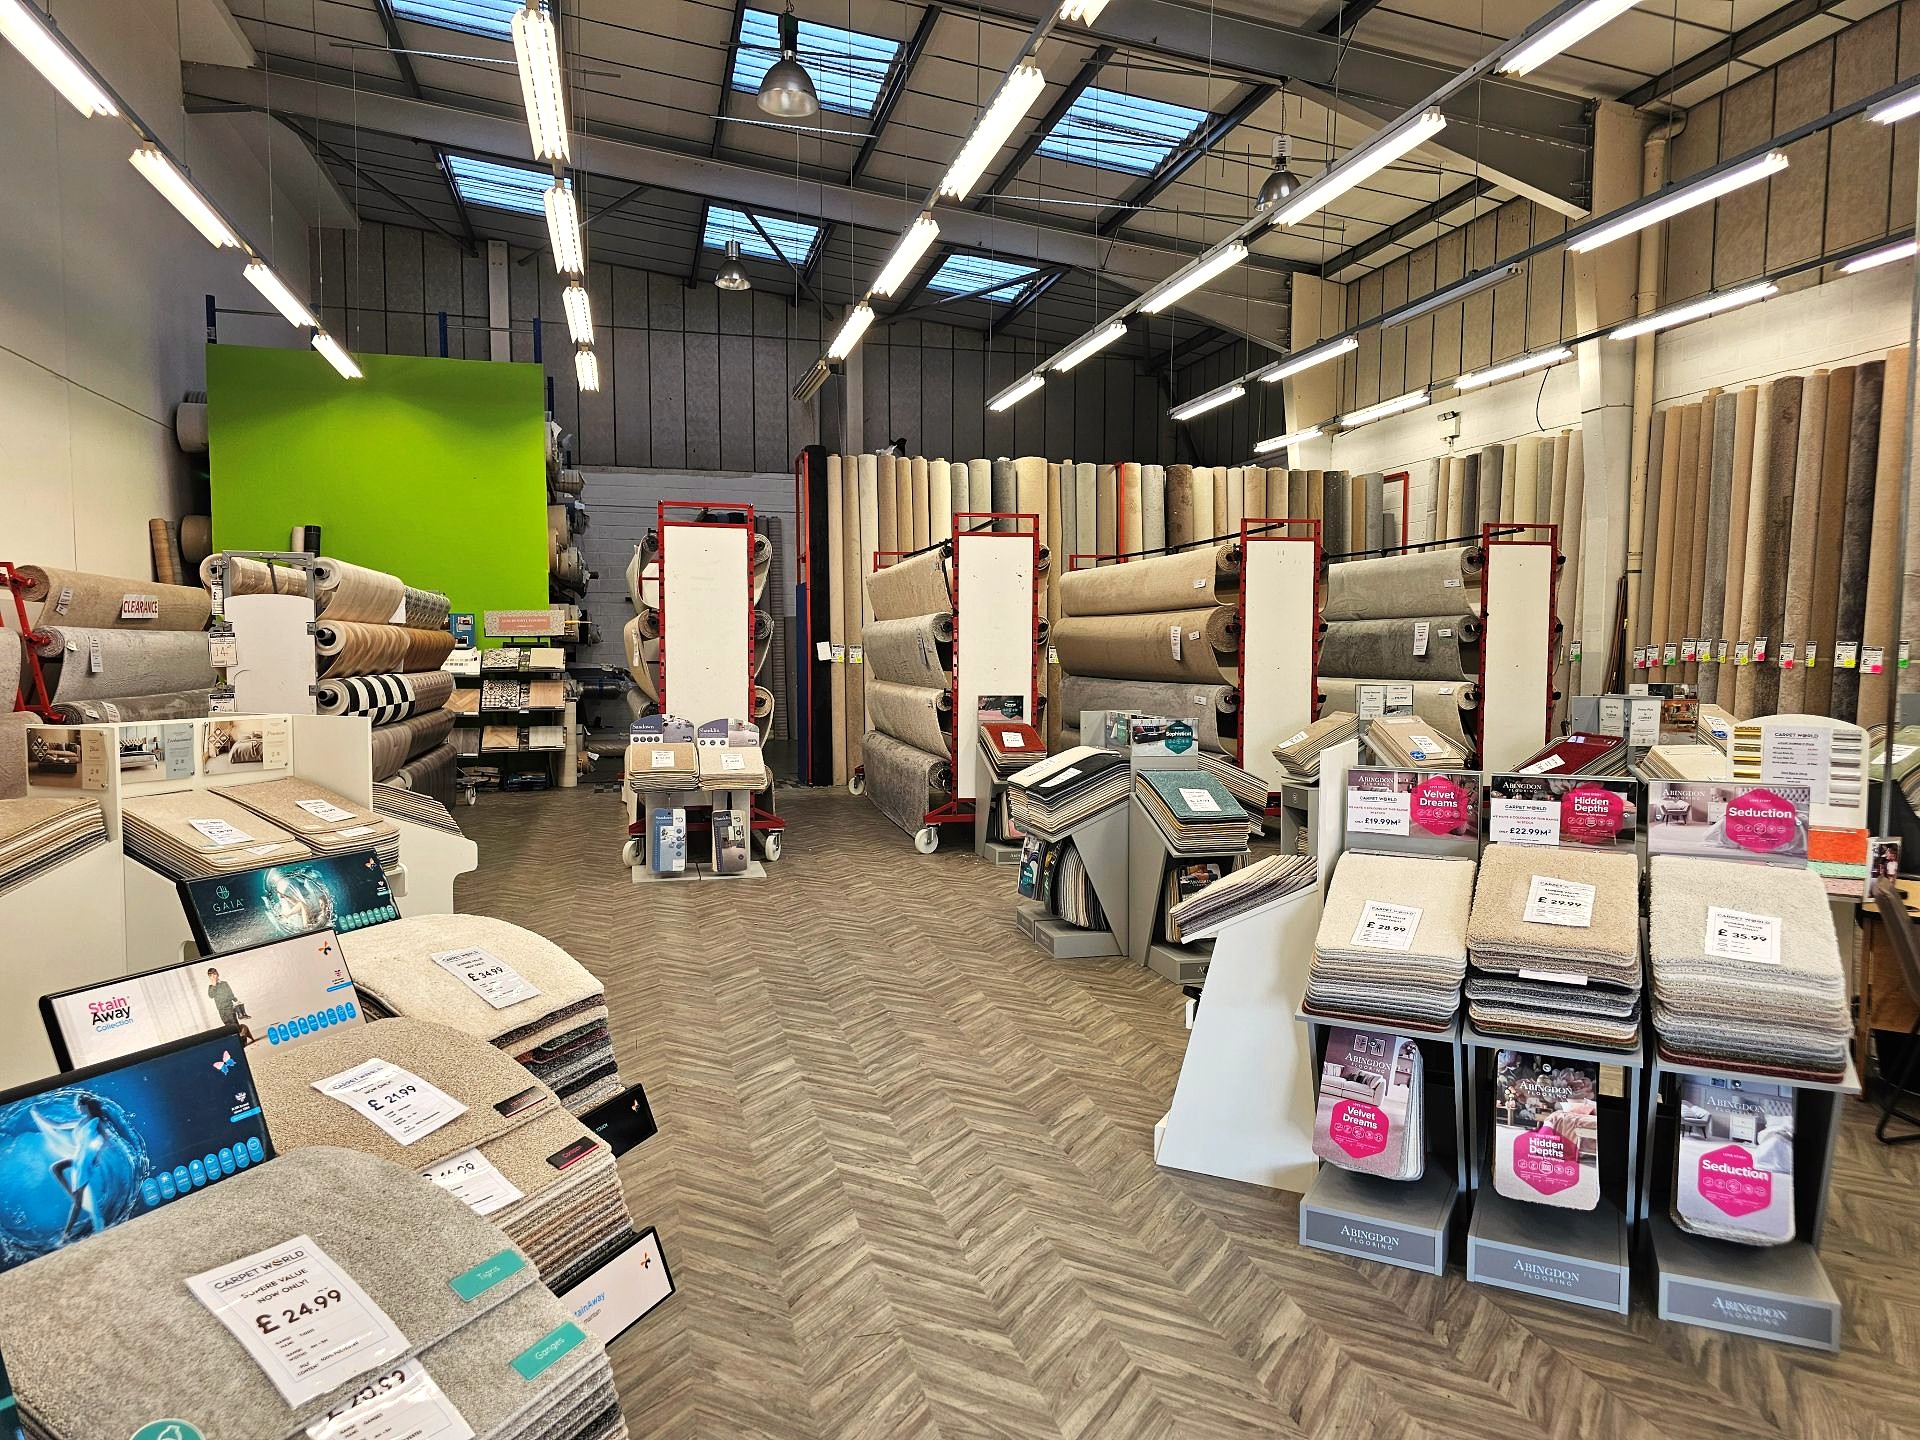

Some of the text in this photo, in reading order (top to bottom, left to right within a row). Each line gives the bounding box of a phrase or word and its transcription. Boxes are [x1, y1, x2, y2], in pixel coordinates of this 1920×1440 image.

[123, 600, 158, 613] CLEARANCE
[1358, 775, 1393, 783] ABINGDON
[1502, 781, 1542, 790] ABINGDON
[1423, 789, 1455, 799] Velvet
[1574, 796, 1609, 805] Hidden
[1662, 788, 1705, 797] ABINGDON
[1419, 798, 1458, 808] Dreams
[1574, 804, 1609, 813] Depths
[1728, 807, 1792, 819] Seduction
[1509, 827, 1552, 836] £22.99M²
[212, 898, 244, 912] GAIA
[1537, 896, 1582, 908] £ 29.99
[1366, 921, 1406, 933] £ 28.99
[1717, 928, 1767, 942] £ 35.99
[467, 966, 504, 982] £ 34.99
[88, 995, 128, 1012] Stain
[92, 1005, 131, 1026] Away
[96, 1017, 134, 1033] Collection
[1344, 1052, 1392, 1071] ABINGDON
[1351, 1062, 1386, 1074] FLOORING
[1519, 1080, 1574, 1096] ABINGDON
[1526, 1090, 1567, 1099] FLOORING
[367, 1085, 417, 1111] £ 21.99
[1706, 1096, 1767, 1114] ABINGDON
[1342, 1112, 1378, 1129] Dreams
[1347, 1105, 1376, 1121] Velvet
[1529, 1136, 1564, 1151] Hidden
[1529, 1145, 1564, 1159] Depths
[1702, 1159, 1769, 1182] Seduction
[1340, 1224, 1399, 1247] ABINGDON
[1349, 1237, 1394, 1252] FLOORING
[214, 1250, 305, 1291] CARPET WORLD
[278, 1268, 309, 1284] VALUE
[1513, 1259, 1580, 1283] ABINGDON
[1523, 1271, 1573, 1288] FLOORING
[257, 1288, 280, 1304] NOW
[256, 1289, 342, 1335] £ 24.99
[1712, 1296, 1788, 1321] ABINGDON
[535, 1336, 566, 1360] Ganges
